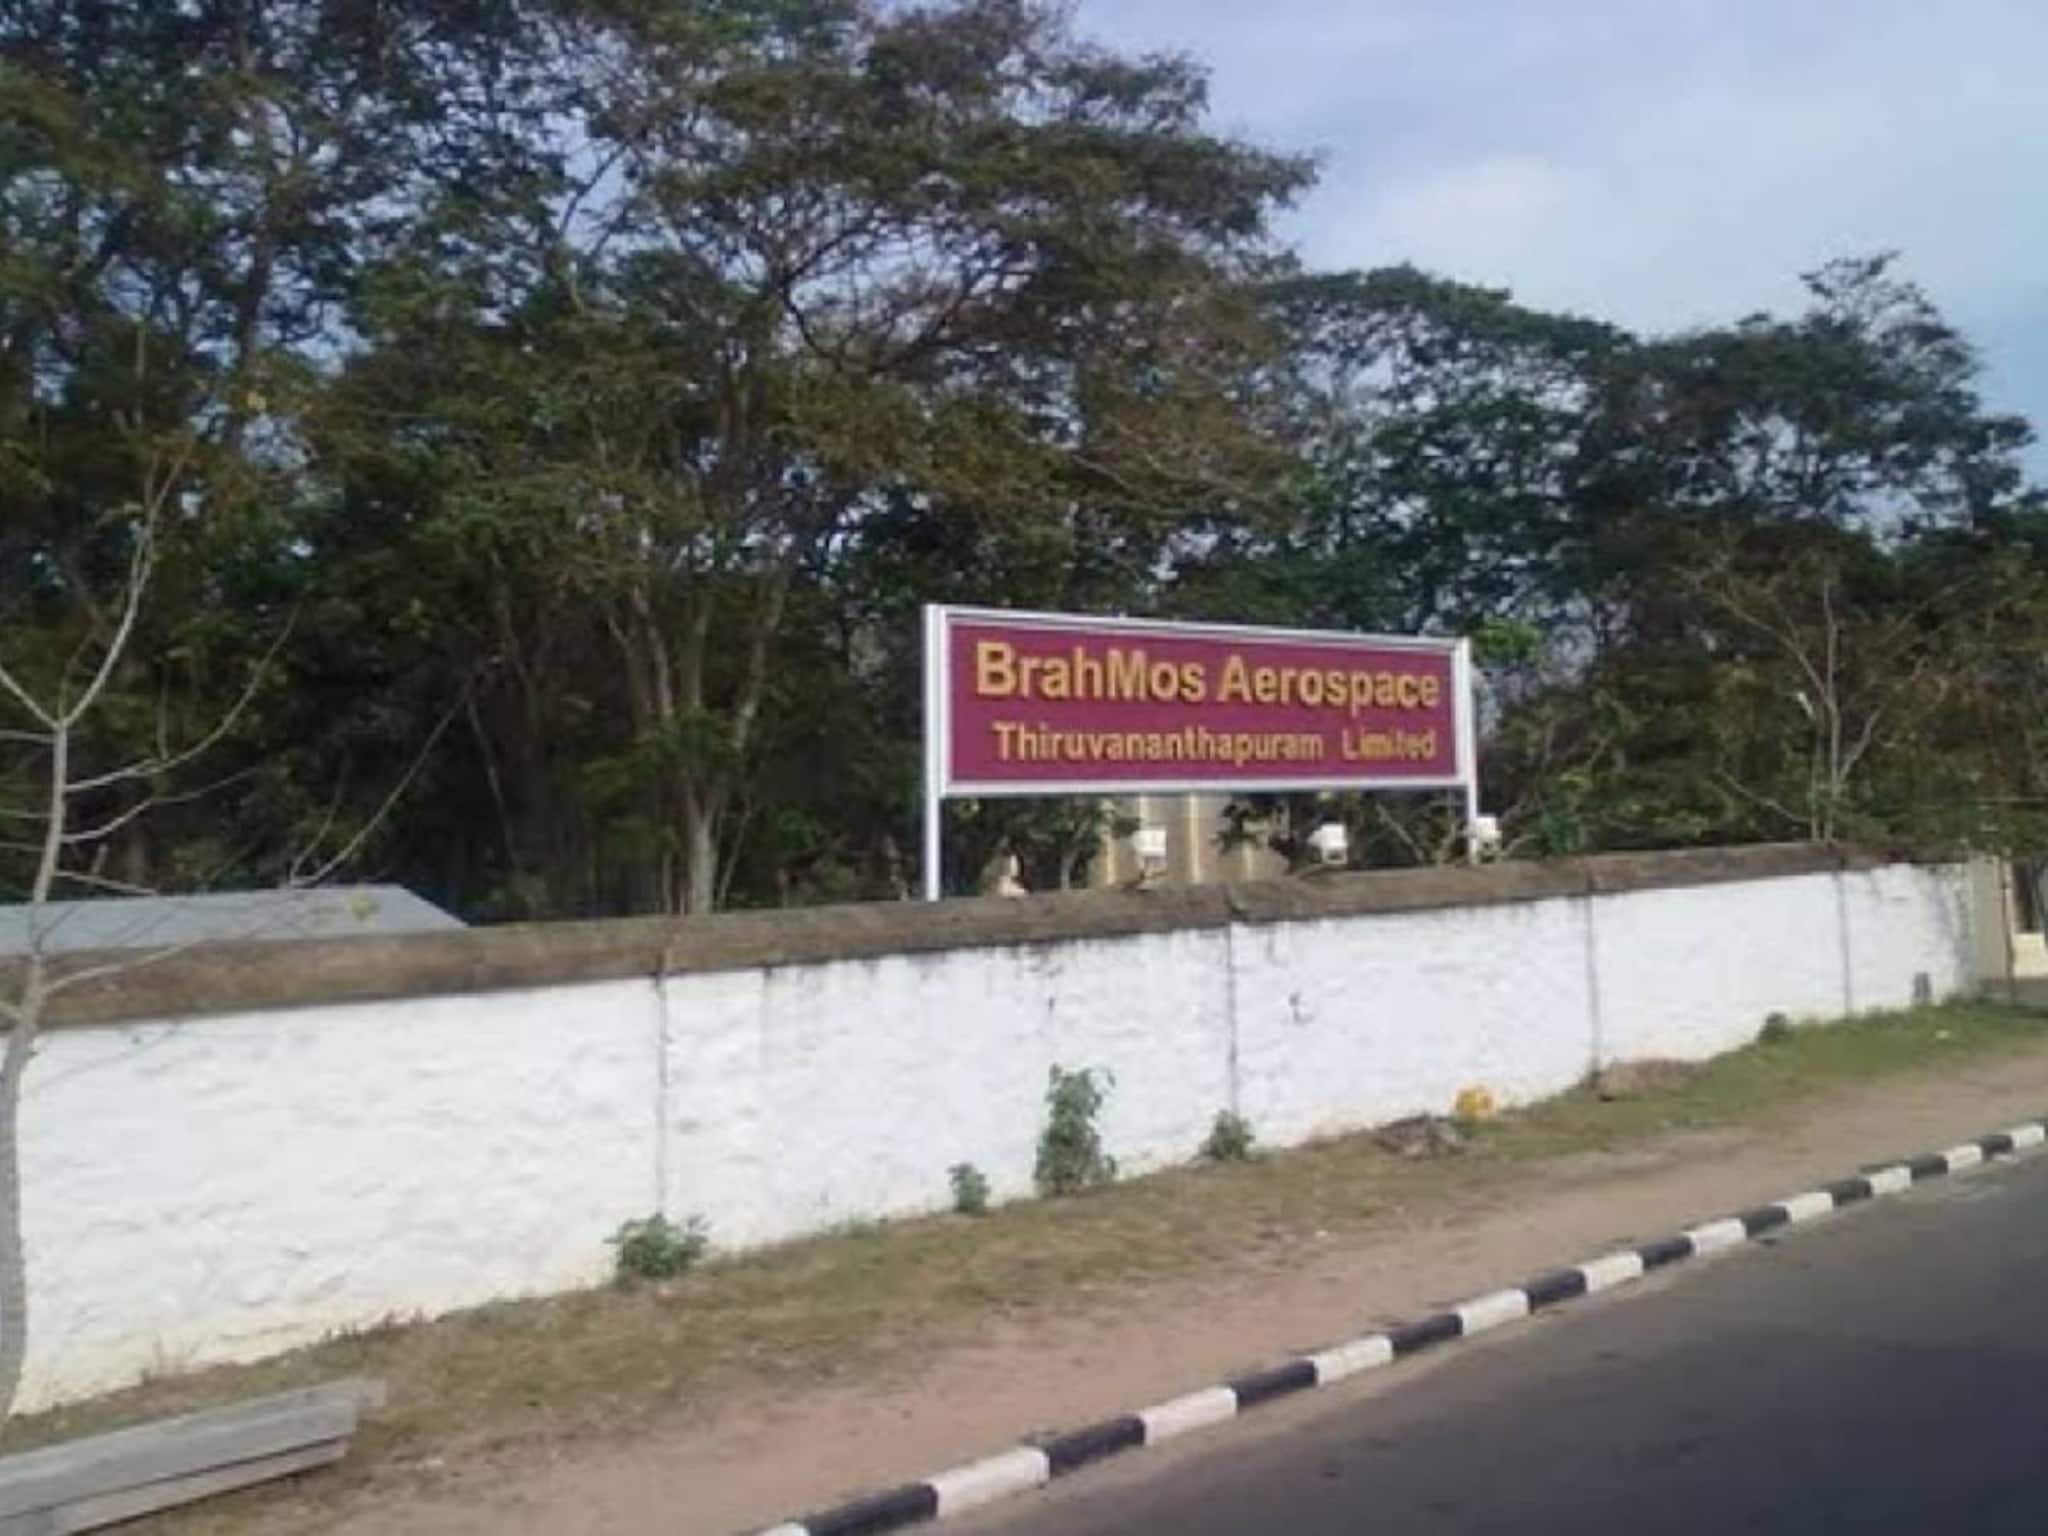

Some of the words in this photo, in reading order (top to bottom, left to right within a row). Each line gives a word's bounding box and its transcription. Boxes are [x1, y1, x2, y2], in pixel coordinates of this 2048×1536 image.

[976, 641, 1206, 700] BrahMos
[1218, 655, 1440, 715] Aerospace
[993, 721, 1323, 767] Thiruvananthapuram
